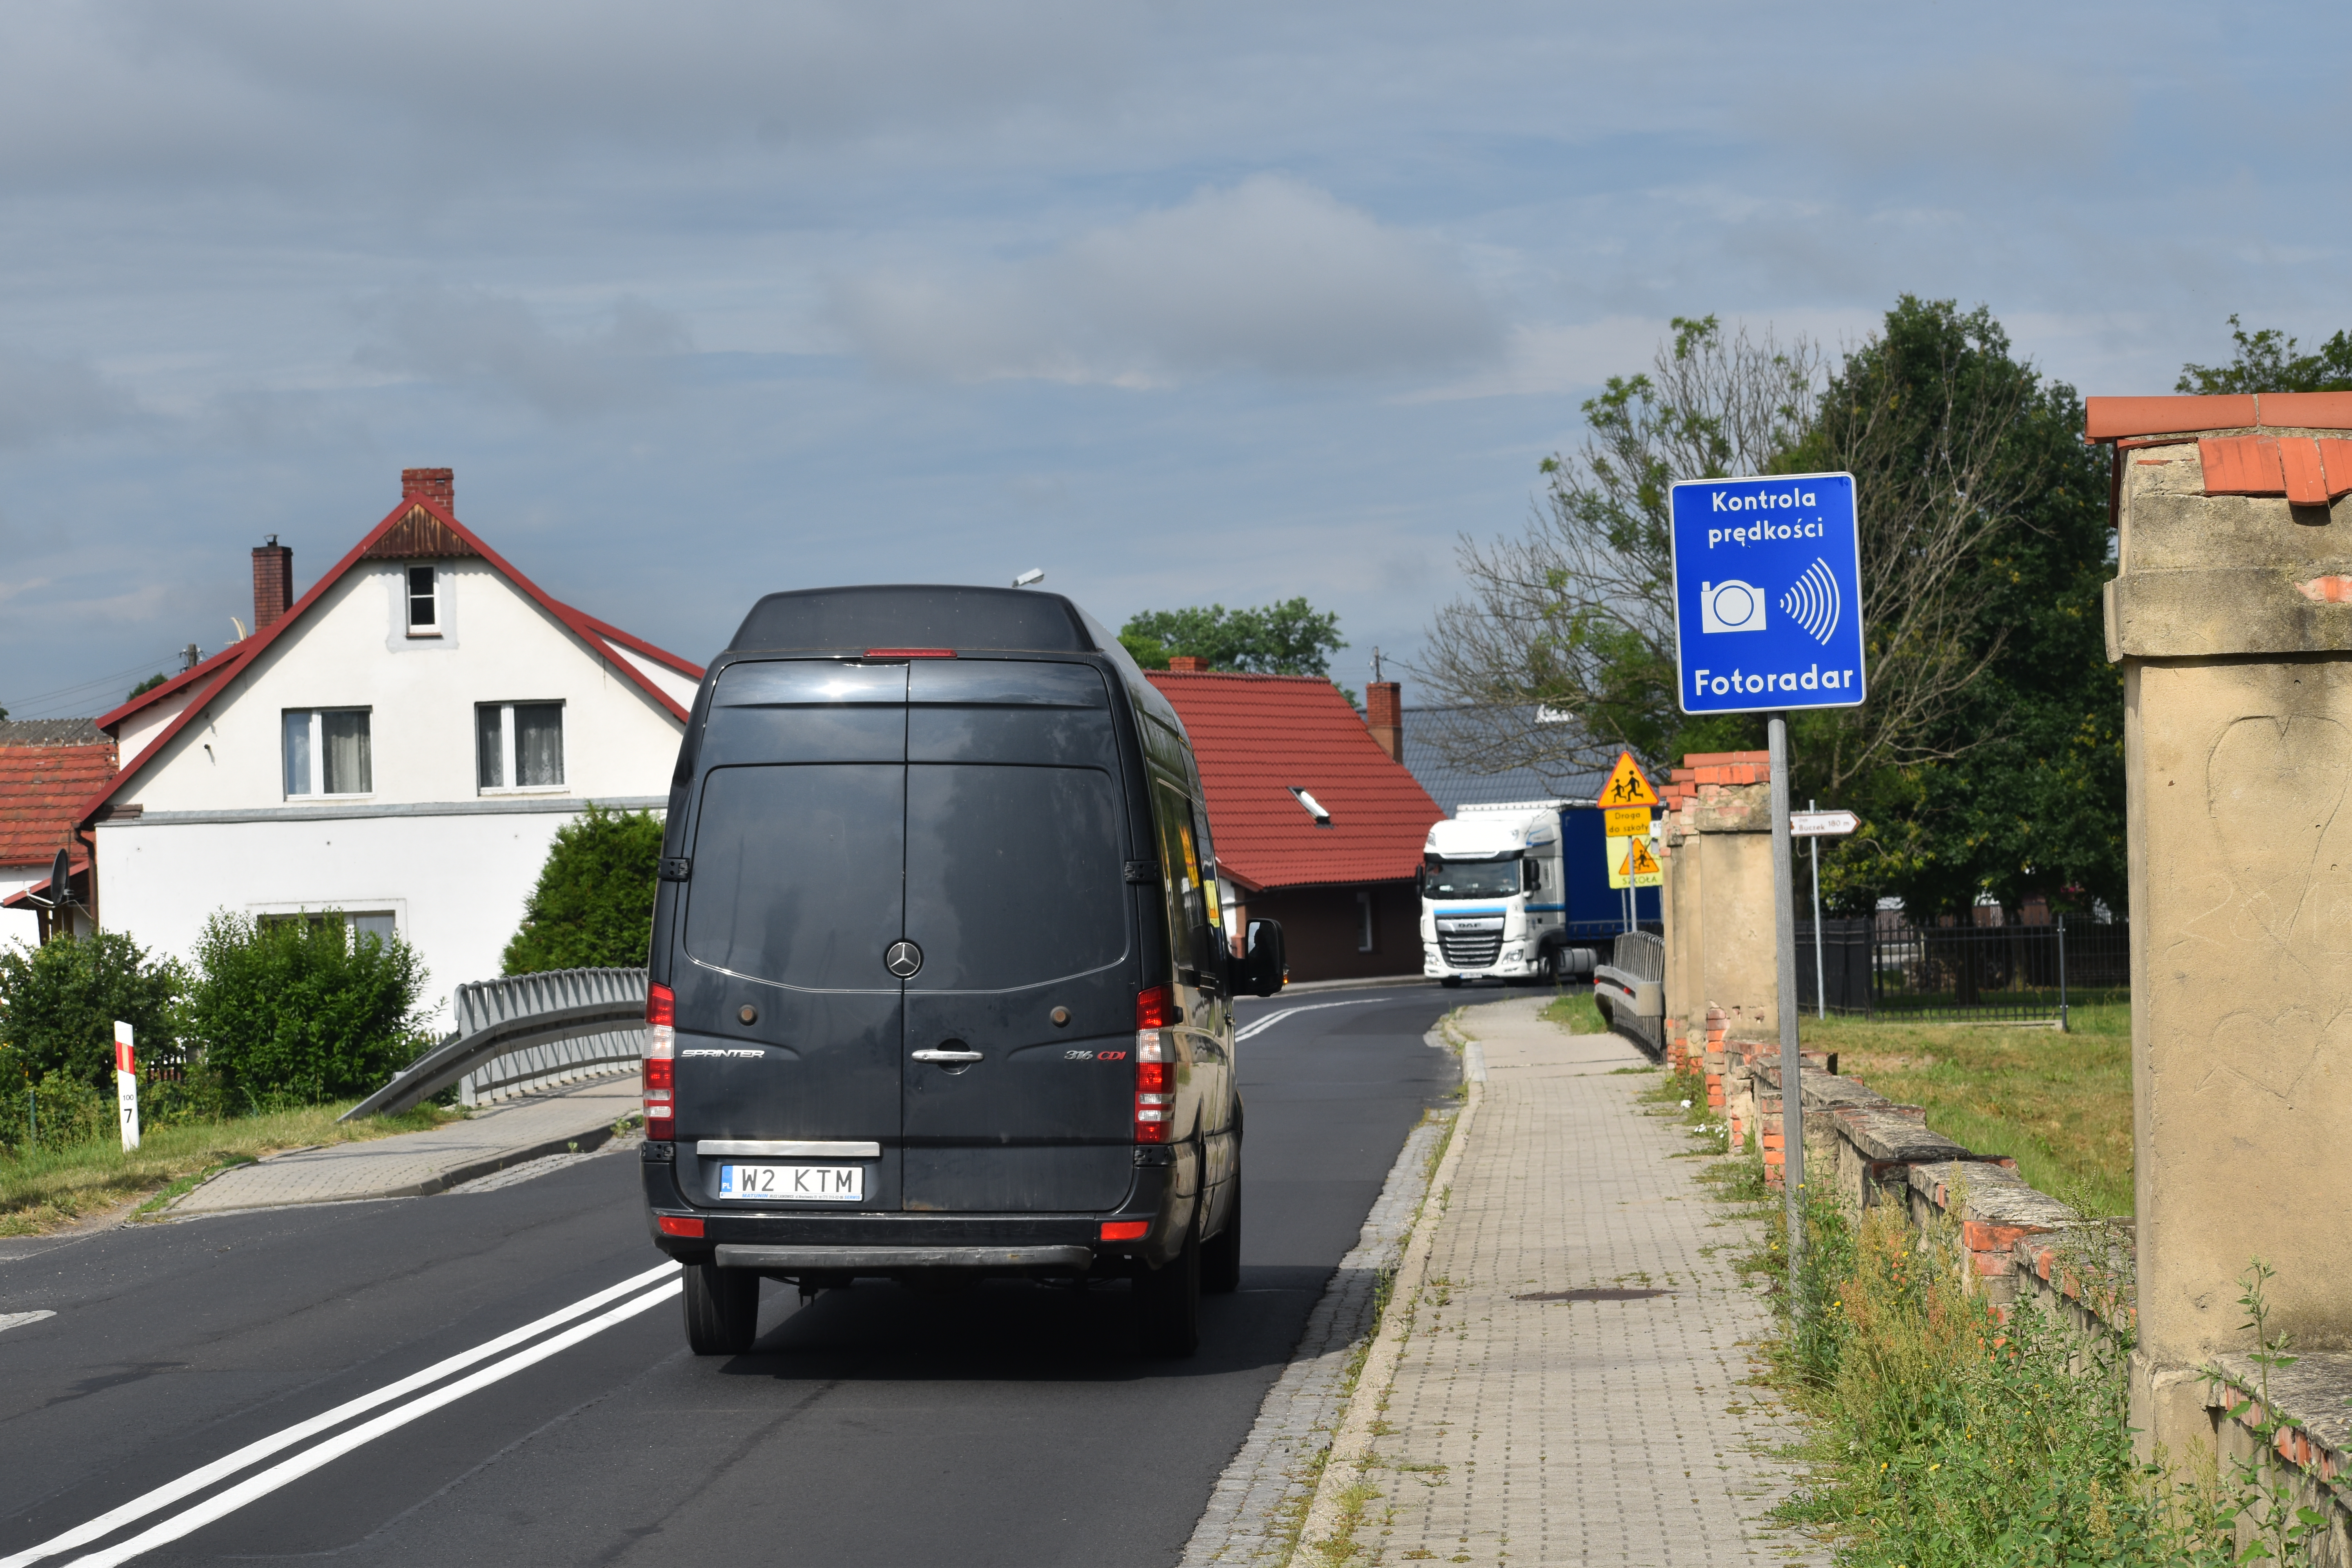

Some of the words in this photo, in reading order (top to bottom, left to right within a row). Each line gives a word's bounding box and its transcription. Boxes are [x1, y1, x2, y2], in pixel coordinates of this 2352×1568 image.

[1712, 488, 1816, 512] Kontrola
[1708, 517, 1823, 549] prędkości
[1695, 664, 1853, 696] Fotoradar
[1623, 824, 1648, 832] szkoły
[681, 1049, 765, 1058] SPRINTER
[1064, 1050, 1093, 1060] 316
[1097, 1051, 1126, 1060] CDI
[124, 1108, 132, 1123] 7
[742, 1169, 775, 1191] W2
[795, 1169, 852, 1192] KTM
